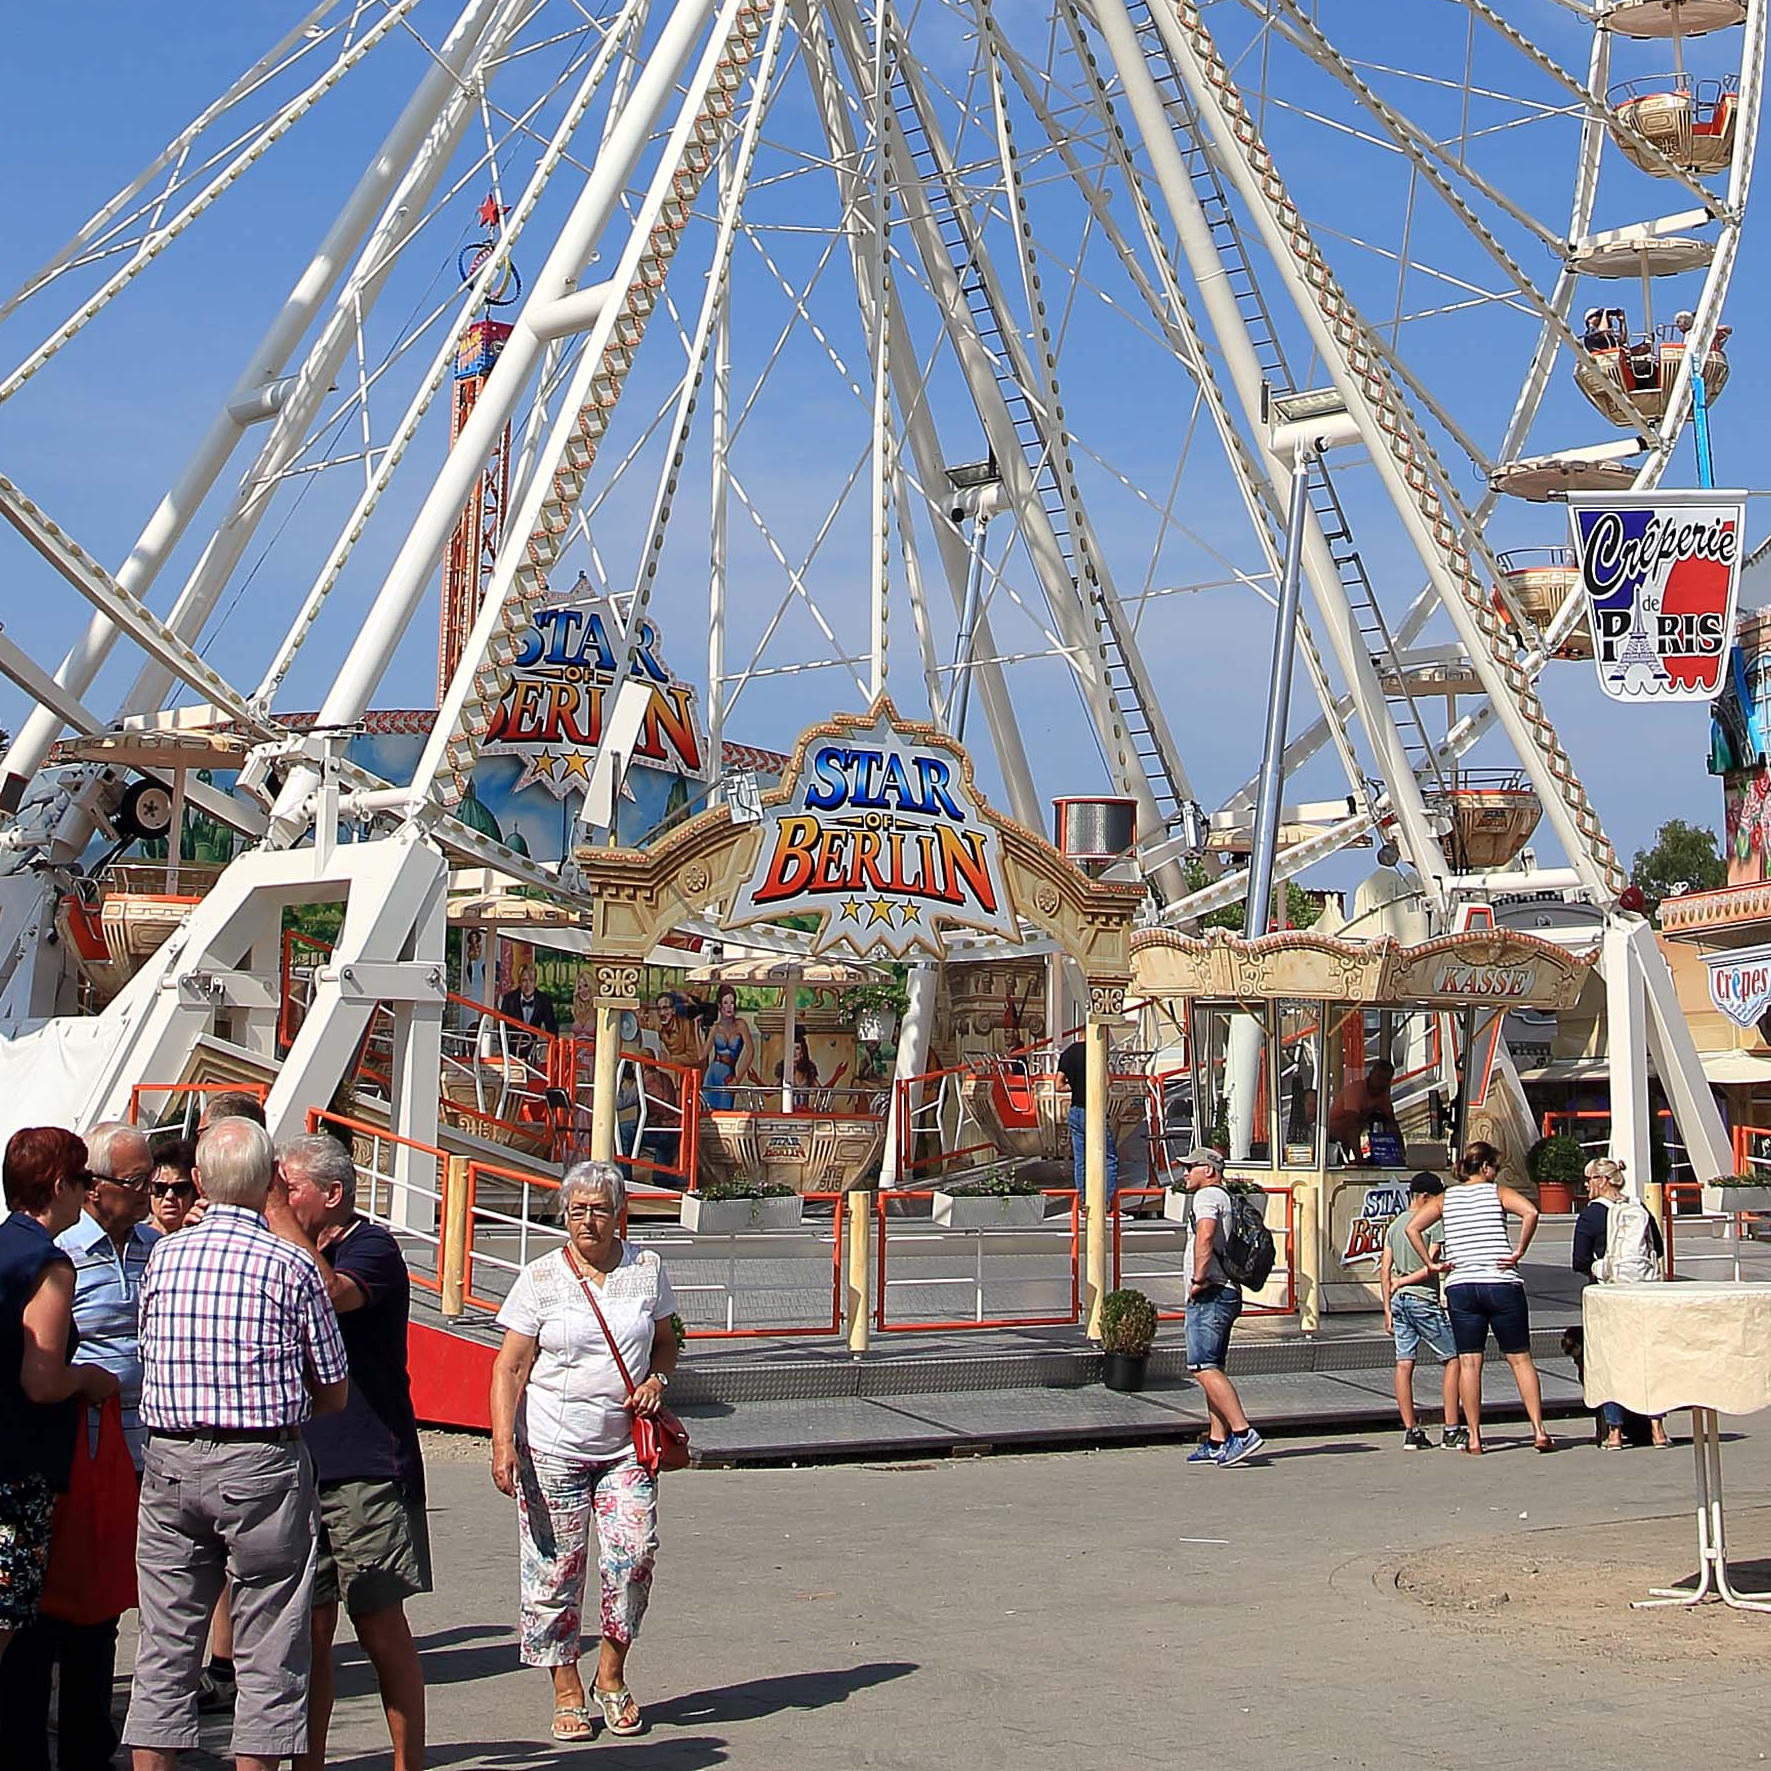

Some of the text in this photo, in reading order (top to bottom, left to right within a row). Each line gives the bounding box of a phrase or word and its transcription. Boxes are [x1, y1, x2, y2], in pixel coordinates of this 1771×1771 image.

[1583, 511, 1738, 597] Crêperie
[1642, 592, 1660, 612] de
[565, 665, 595, 685] OF
[804, 746, 966, 823] STAR
[864, 812, 894, 831] OF
[751, 815, 999, 915] BERLIN
[1439, 966, 1529, 996] KASSE
[1716, 966, 1769, 1002] Crêpes
[1363, 1189, 1412, 1218] STA
